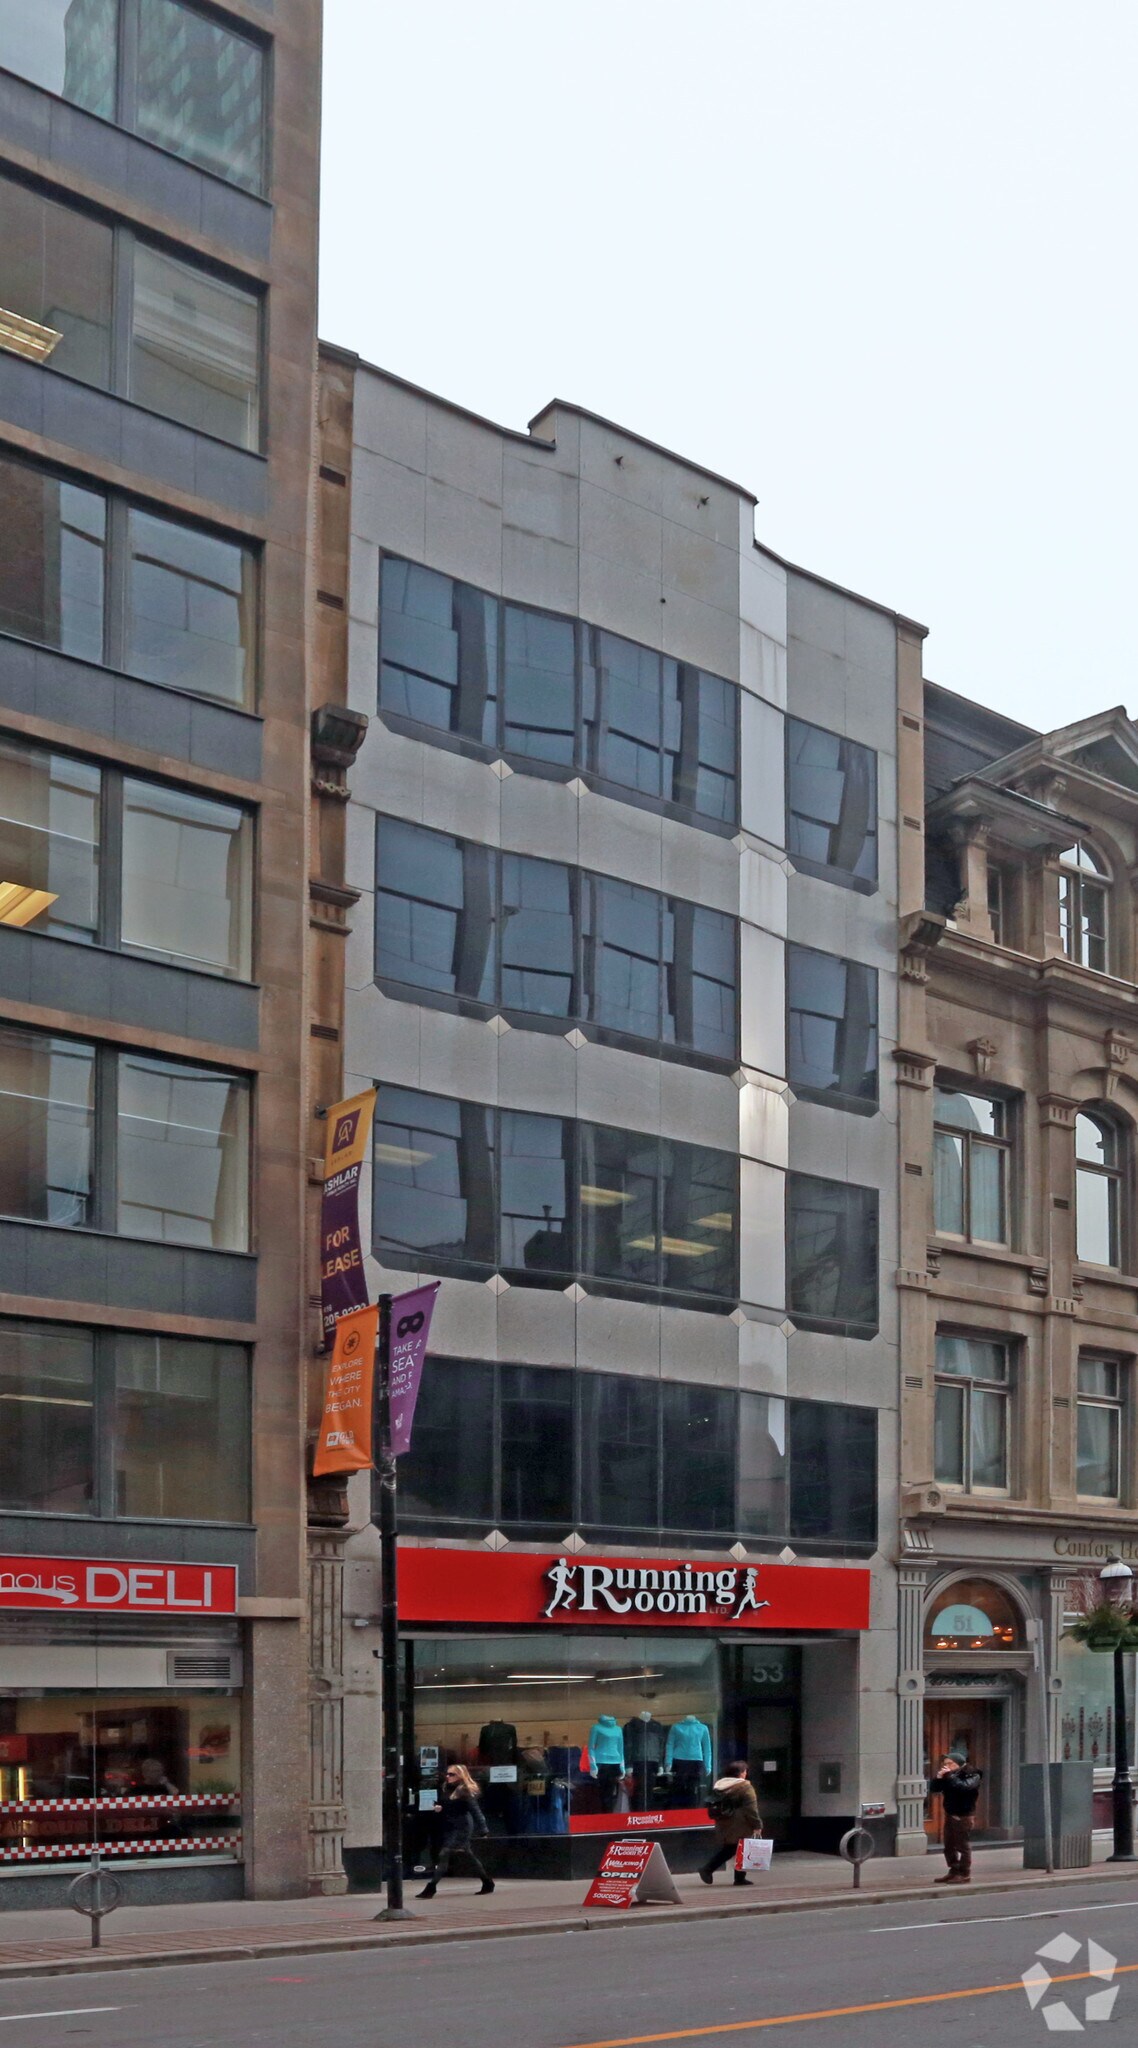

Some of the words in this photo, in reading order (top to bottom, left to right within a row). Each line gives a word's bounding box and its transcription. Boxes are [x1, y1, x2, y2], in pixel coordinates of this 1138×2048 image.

[326, 1226, 350, 1251] FOR
[394, 1341, 413, 1356] TAKE
[332, 1357, 363, 1373] EXPLORE
[330, 1370, 362, 1386] WHERE
[86, 1567, 212, 1607] DELI
[578, 1564, 738, 1614] Running
[954, 1615, 973, 1632] 51
[752, 1662, 783, 1683] 53
